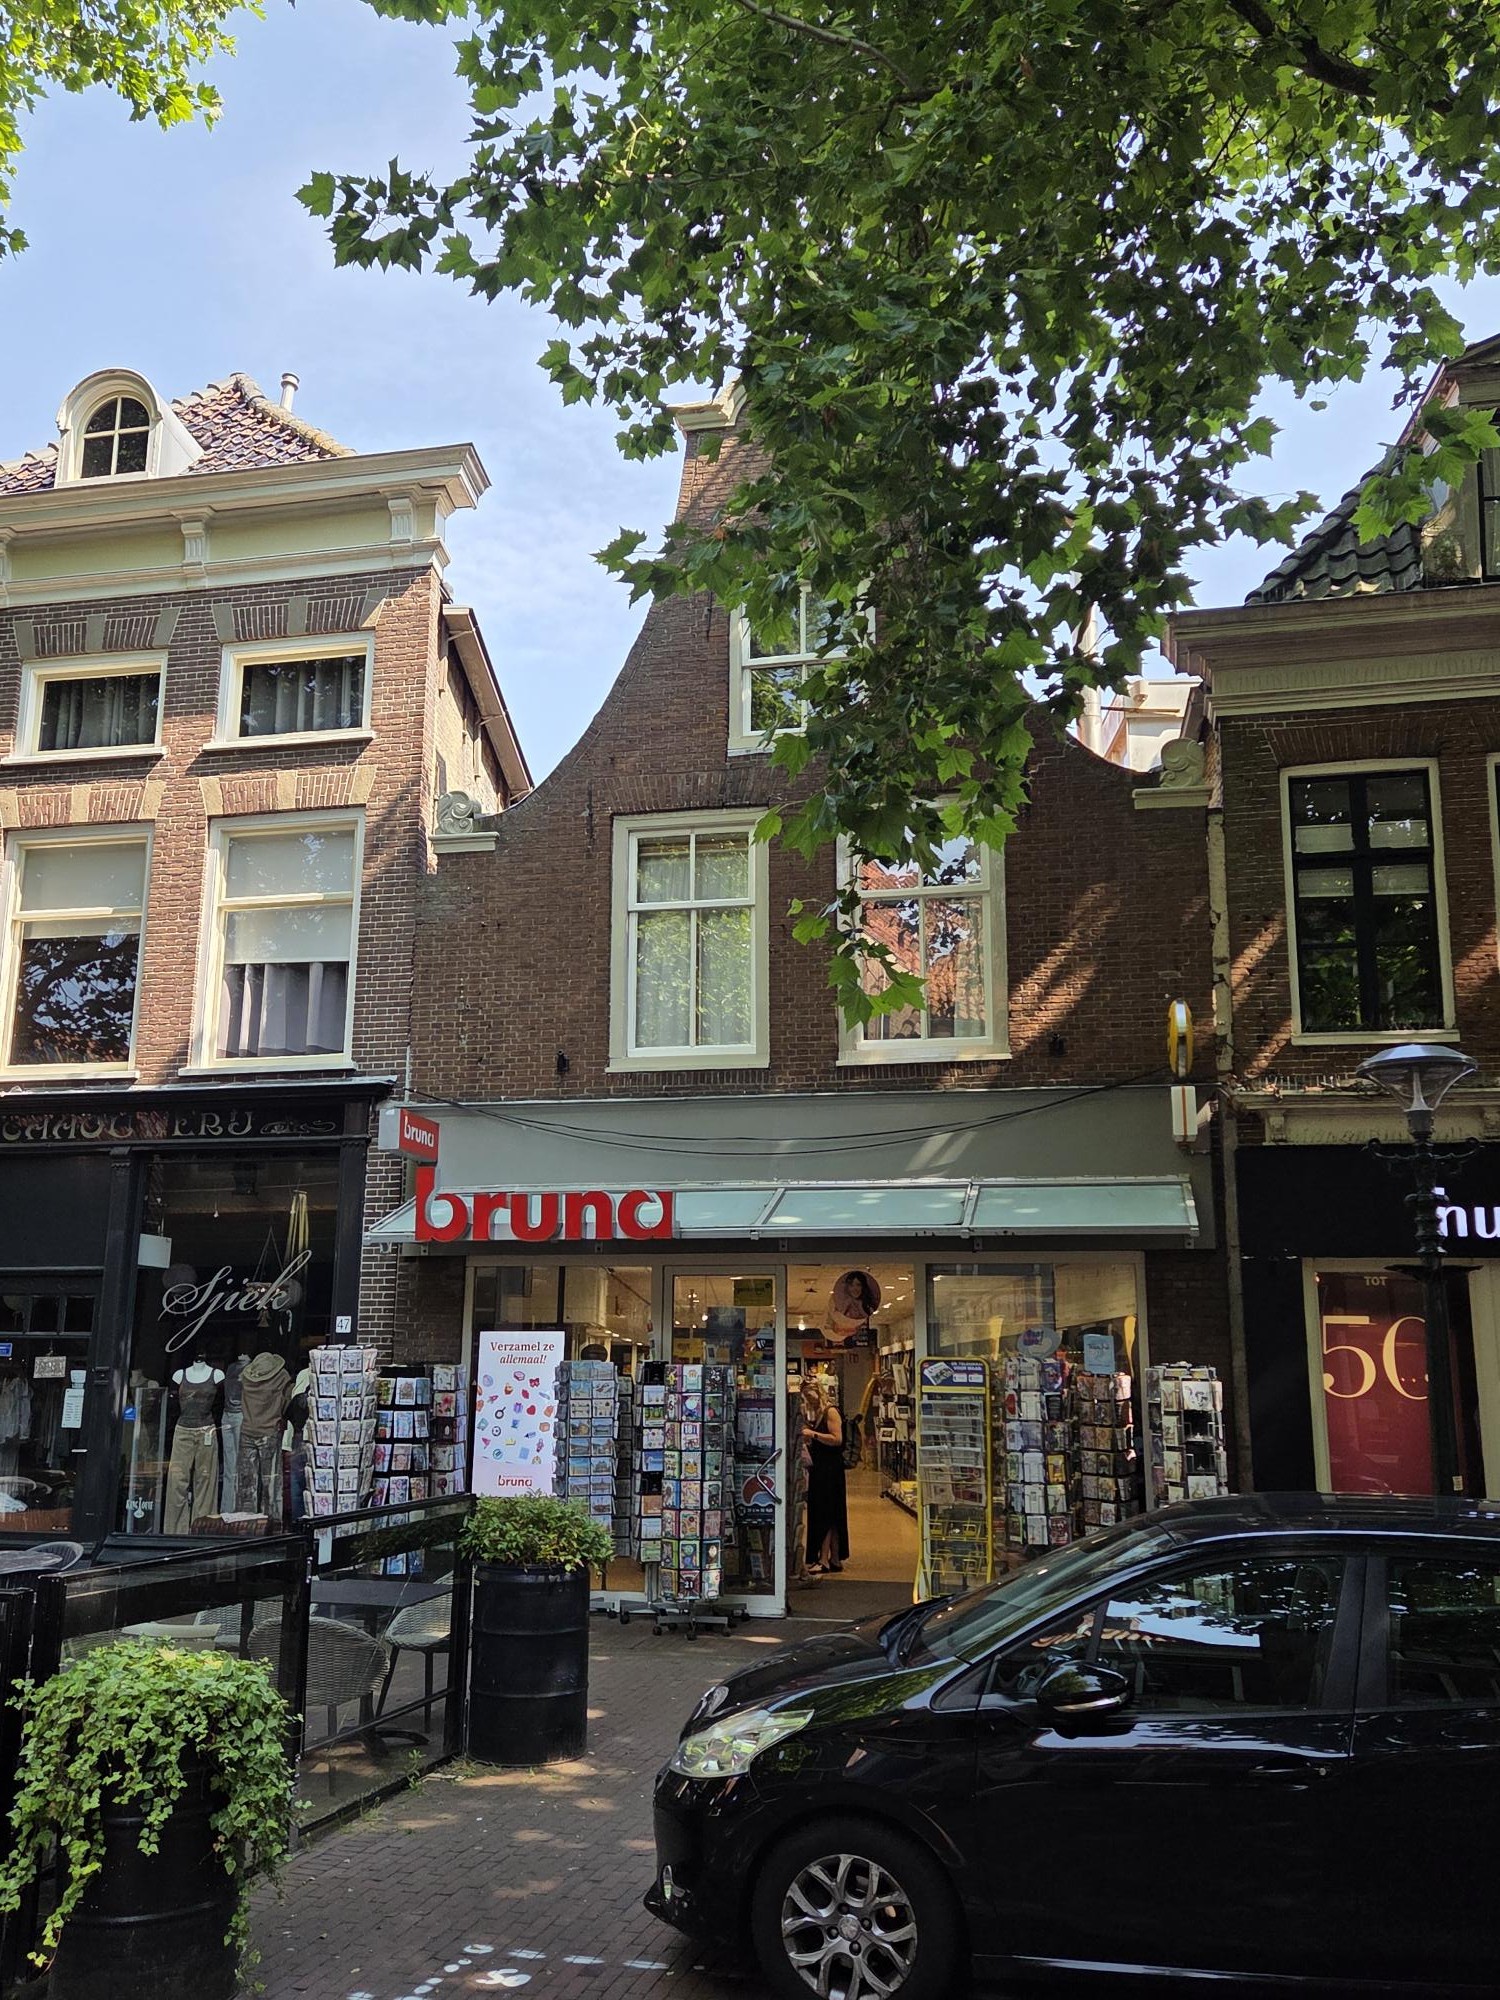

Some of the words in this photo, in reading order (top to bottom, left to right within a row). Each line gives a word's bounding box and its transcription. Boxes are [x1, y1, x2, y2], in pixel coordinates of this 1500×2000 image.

[403, 1116, 435, 1148] bruna
[415, 1167, 674, 1241] bruna
[1364, 1275, 1388, 1286] TOT
[158, 1250, 313, 1353] Sjiek
[337, 1318, 350, 1331] 47
[490, 1341, 541, 1352] Verzamel
[543, 1343, 555, 1352] ze
[499, 1354, 547, 1365] allemaal!
[498, 1475, 532, 1487] bruna
